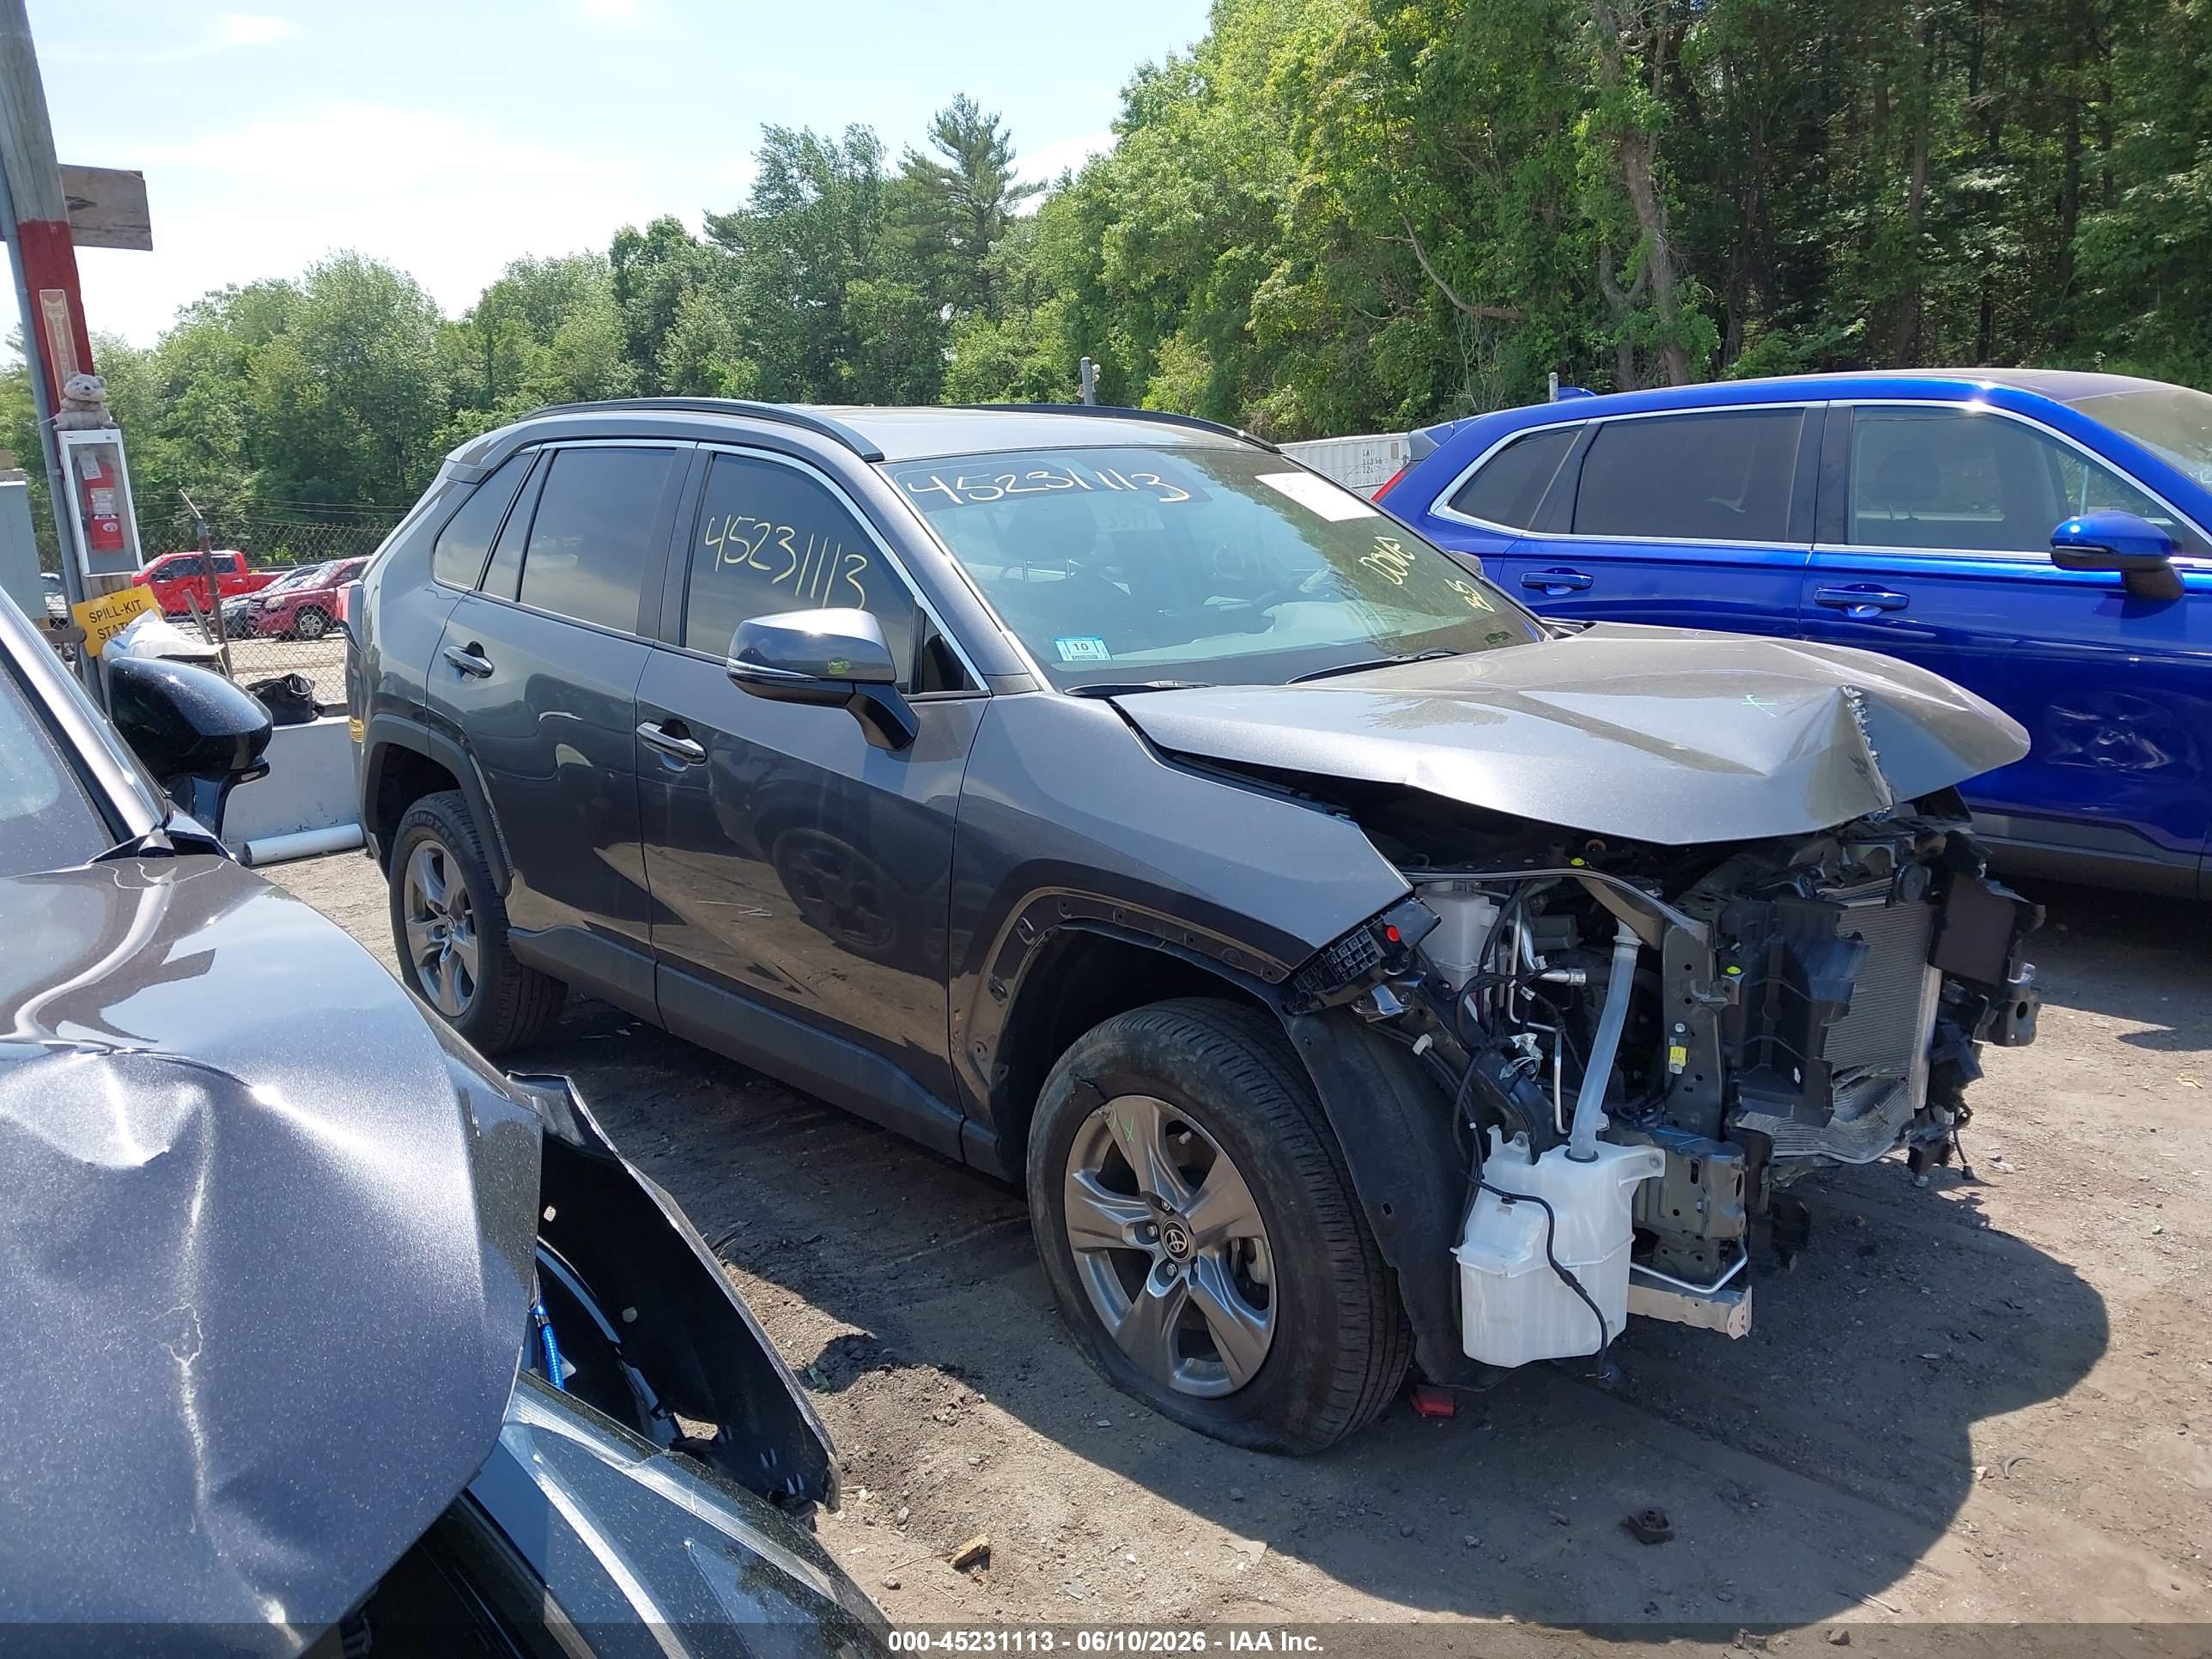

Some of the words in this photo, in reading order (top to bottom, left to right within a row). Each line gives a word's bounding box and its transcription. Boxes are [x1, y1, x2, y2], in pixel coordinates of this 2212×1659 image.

[907, 468, 1192, 505] 45231113
[704, 514, 868, 611] 45231113
[88, 599, 143, 623] SPILL-KIT
[97, 622, 130, 641] STAT
[1073, 642, 1090, 651] 10
